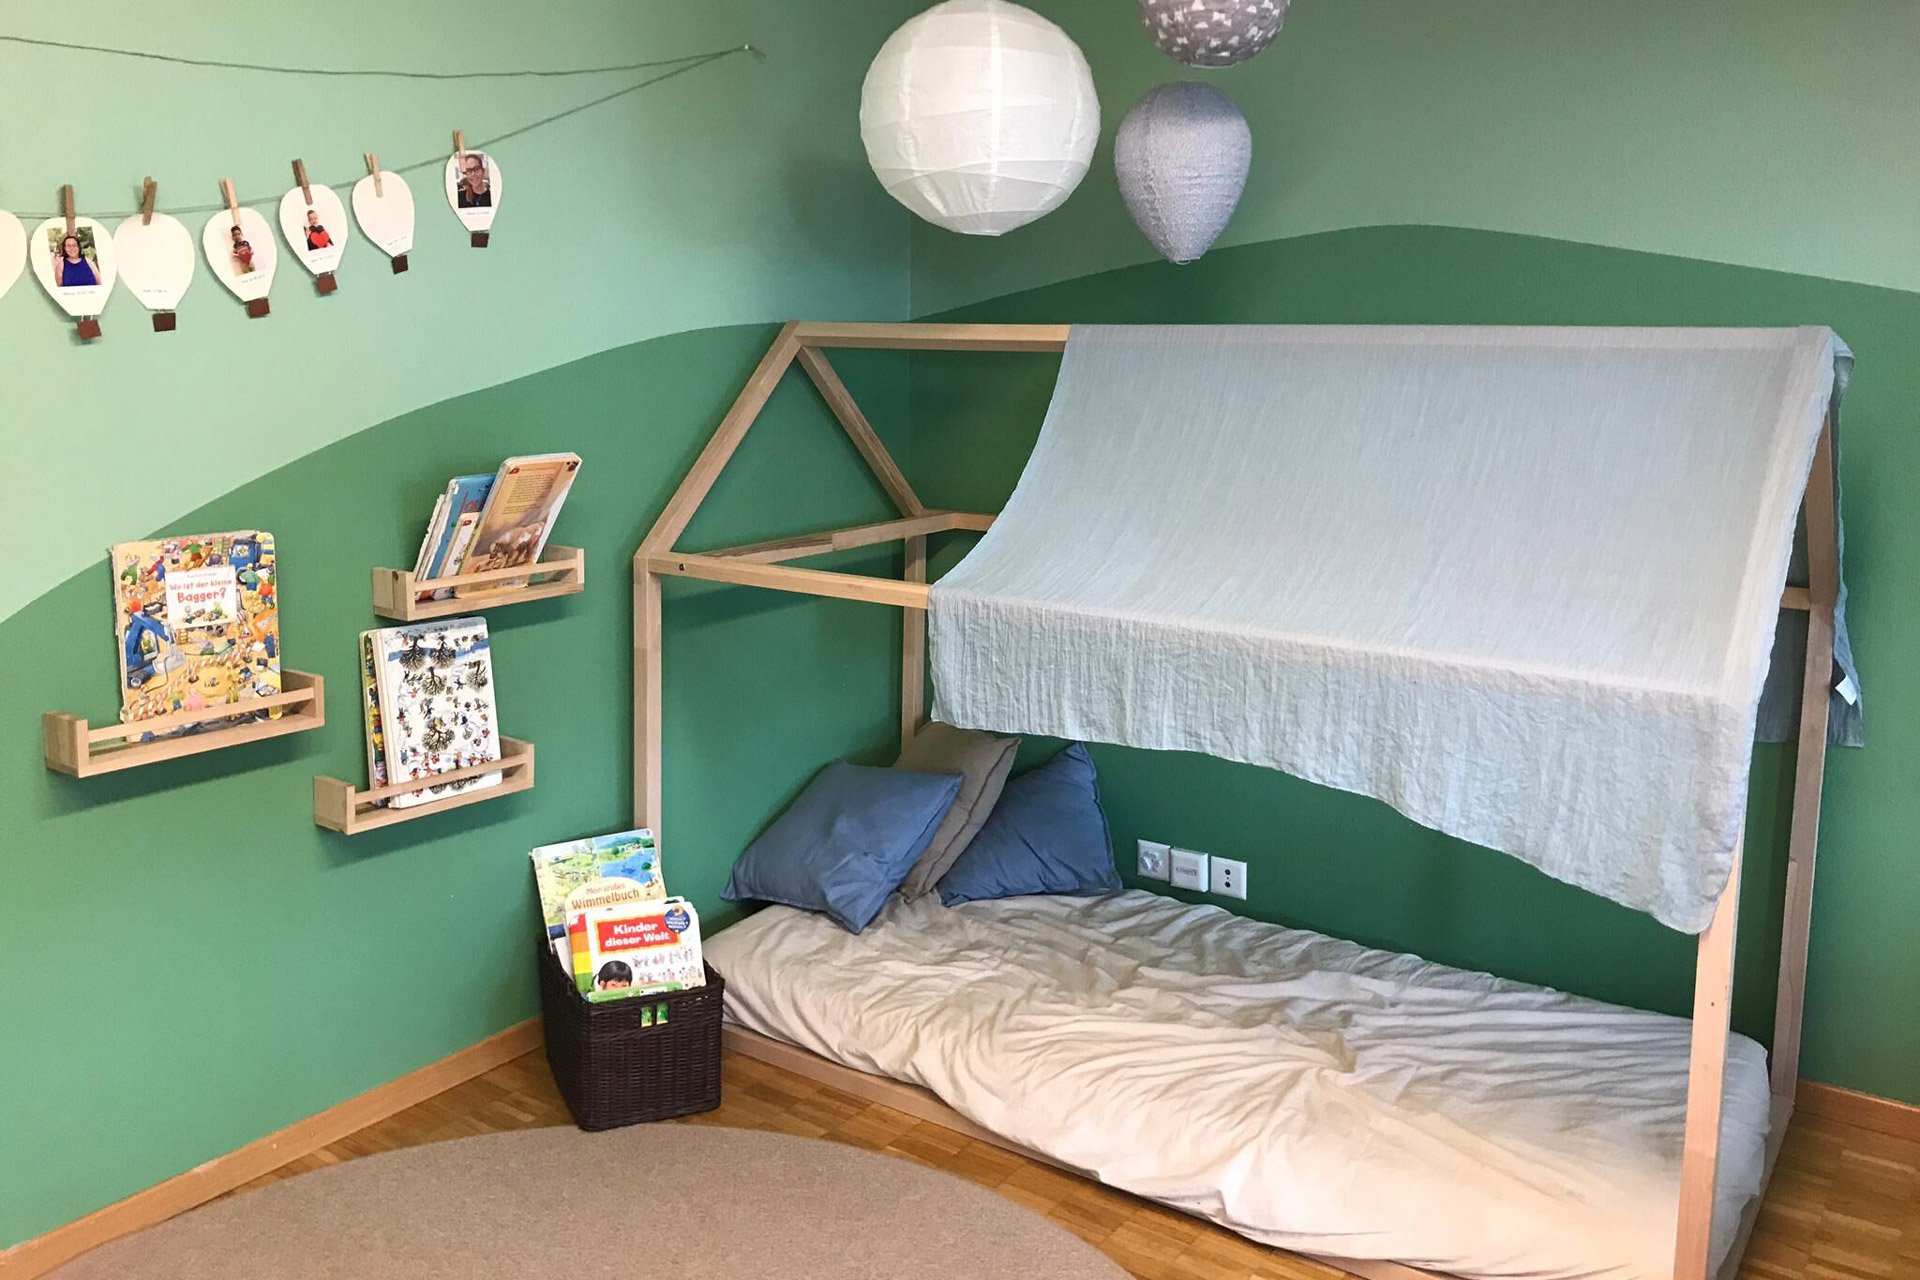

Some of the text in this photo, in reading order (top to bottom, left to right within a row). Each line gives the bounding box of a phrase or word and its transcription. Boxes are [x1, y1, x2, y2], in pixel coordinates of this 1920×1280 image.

[177, 587, 226, 603] Bagger?
[571, 888, 640, 909] Wimmelbuch
[613, 922, 658, 935] Kinder
[604, 931, 670, 947] dieser Welt
